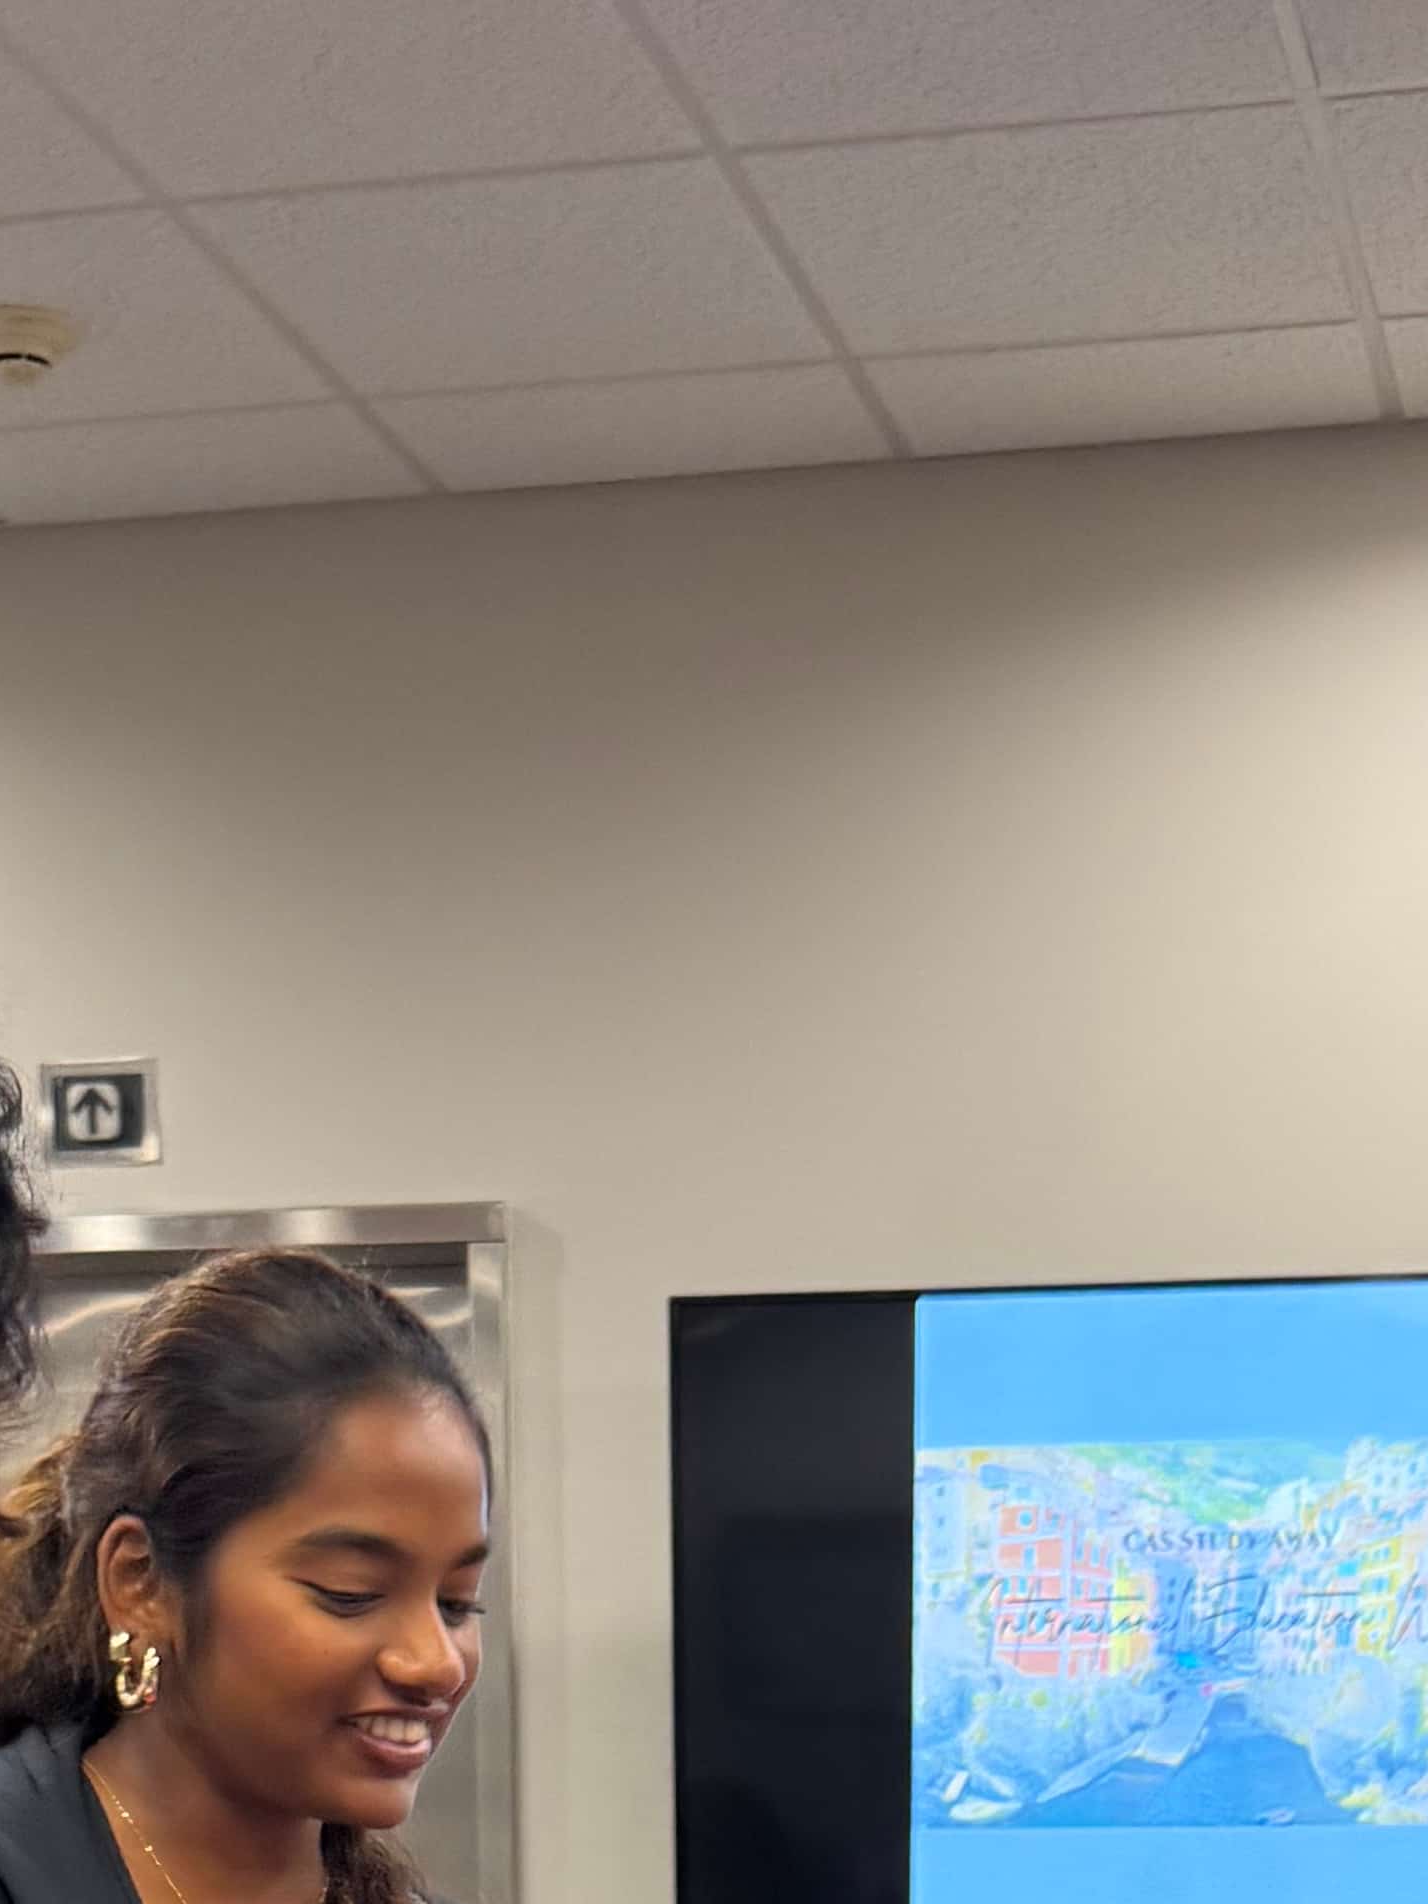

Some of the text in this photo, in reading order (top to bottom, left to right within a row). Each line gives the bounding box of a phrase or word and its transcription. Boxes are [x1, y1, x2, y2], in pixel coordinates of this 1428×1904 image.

[1123, 1529, 1177, 1554] CAS
[983, 1574, 1194, 1668] International
[1200, 1573, 1376, 1655] Education
